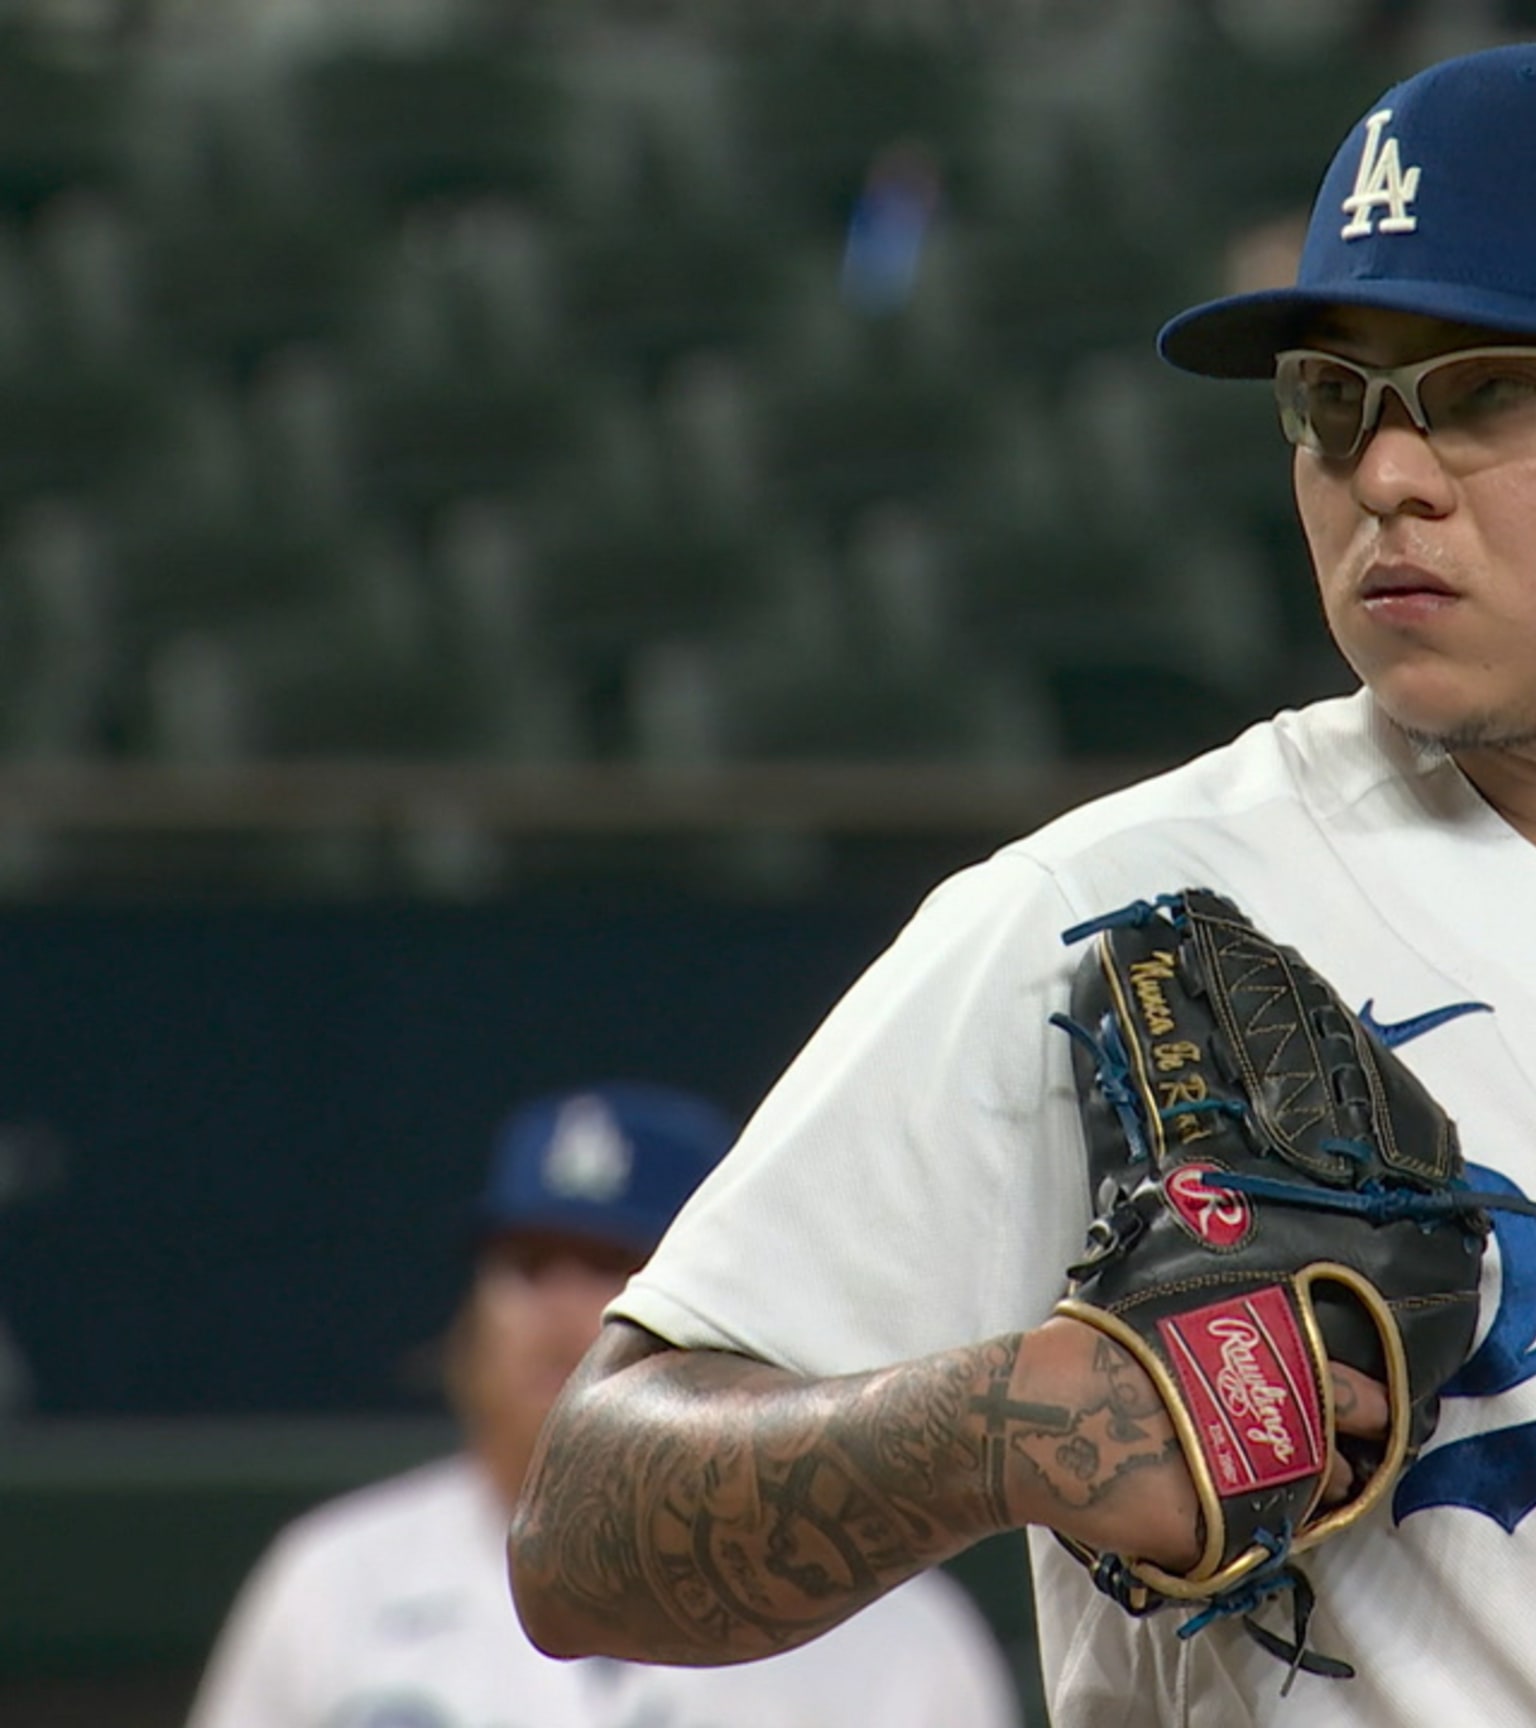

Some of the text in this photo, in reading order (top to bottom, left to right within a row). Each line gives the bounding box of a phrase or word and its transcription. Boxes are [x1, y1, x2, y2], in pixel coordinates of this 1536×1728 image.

[1340, 108, 1422, 241] LA
[1129, 951, 1176, 1036] Nunca
[1206, 1317, 1297, 1465] Rawlings
